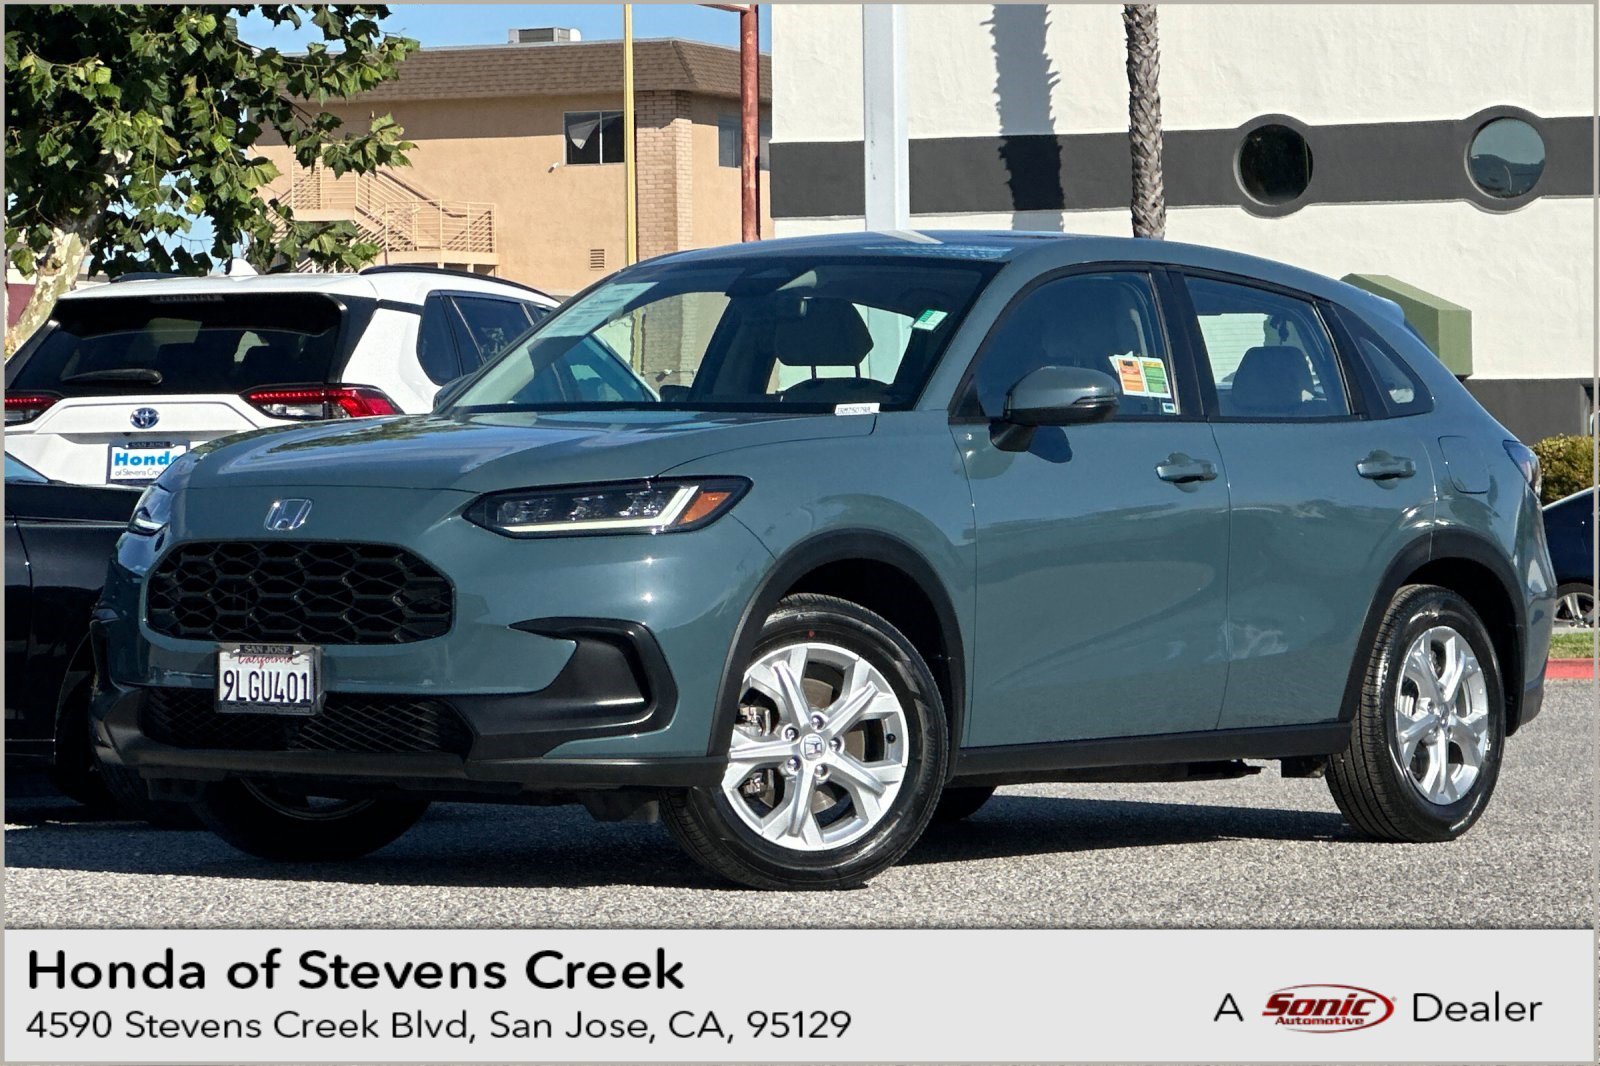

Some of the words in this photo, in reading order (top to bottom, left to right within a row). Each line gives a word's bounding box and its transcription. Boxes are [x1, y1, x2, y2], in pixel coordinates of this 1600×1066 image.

[244, 645, 263, 654] SAN
[266, 646, 290, 654] JOSE
[223, 669, 312, 703] 9LGU401
